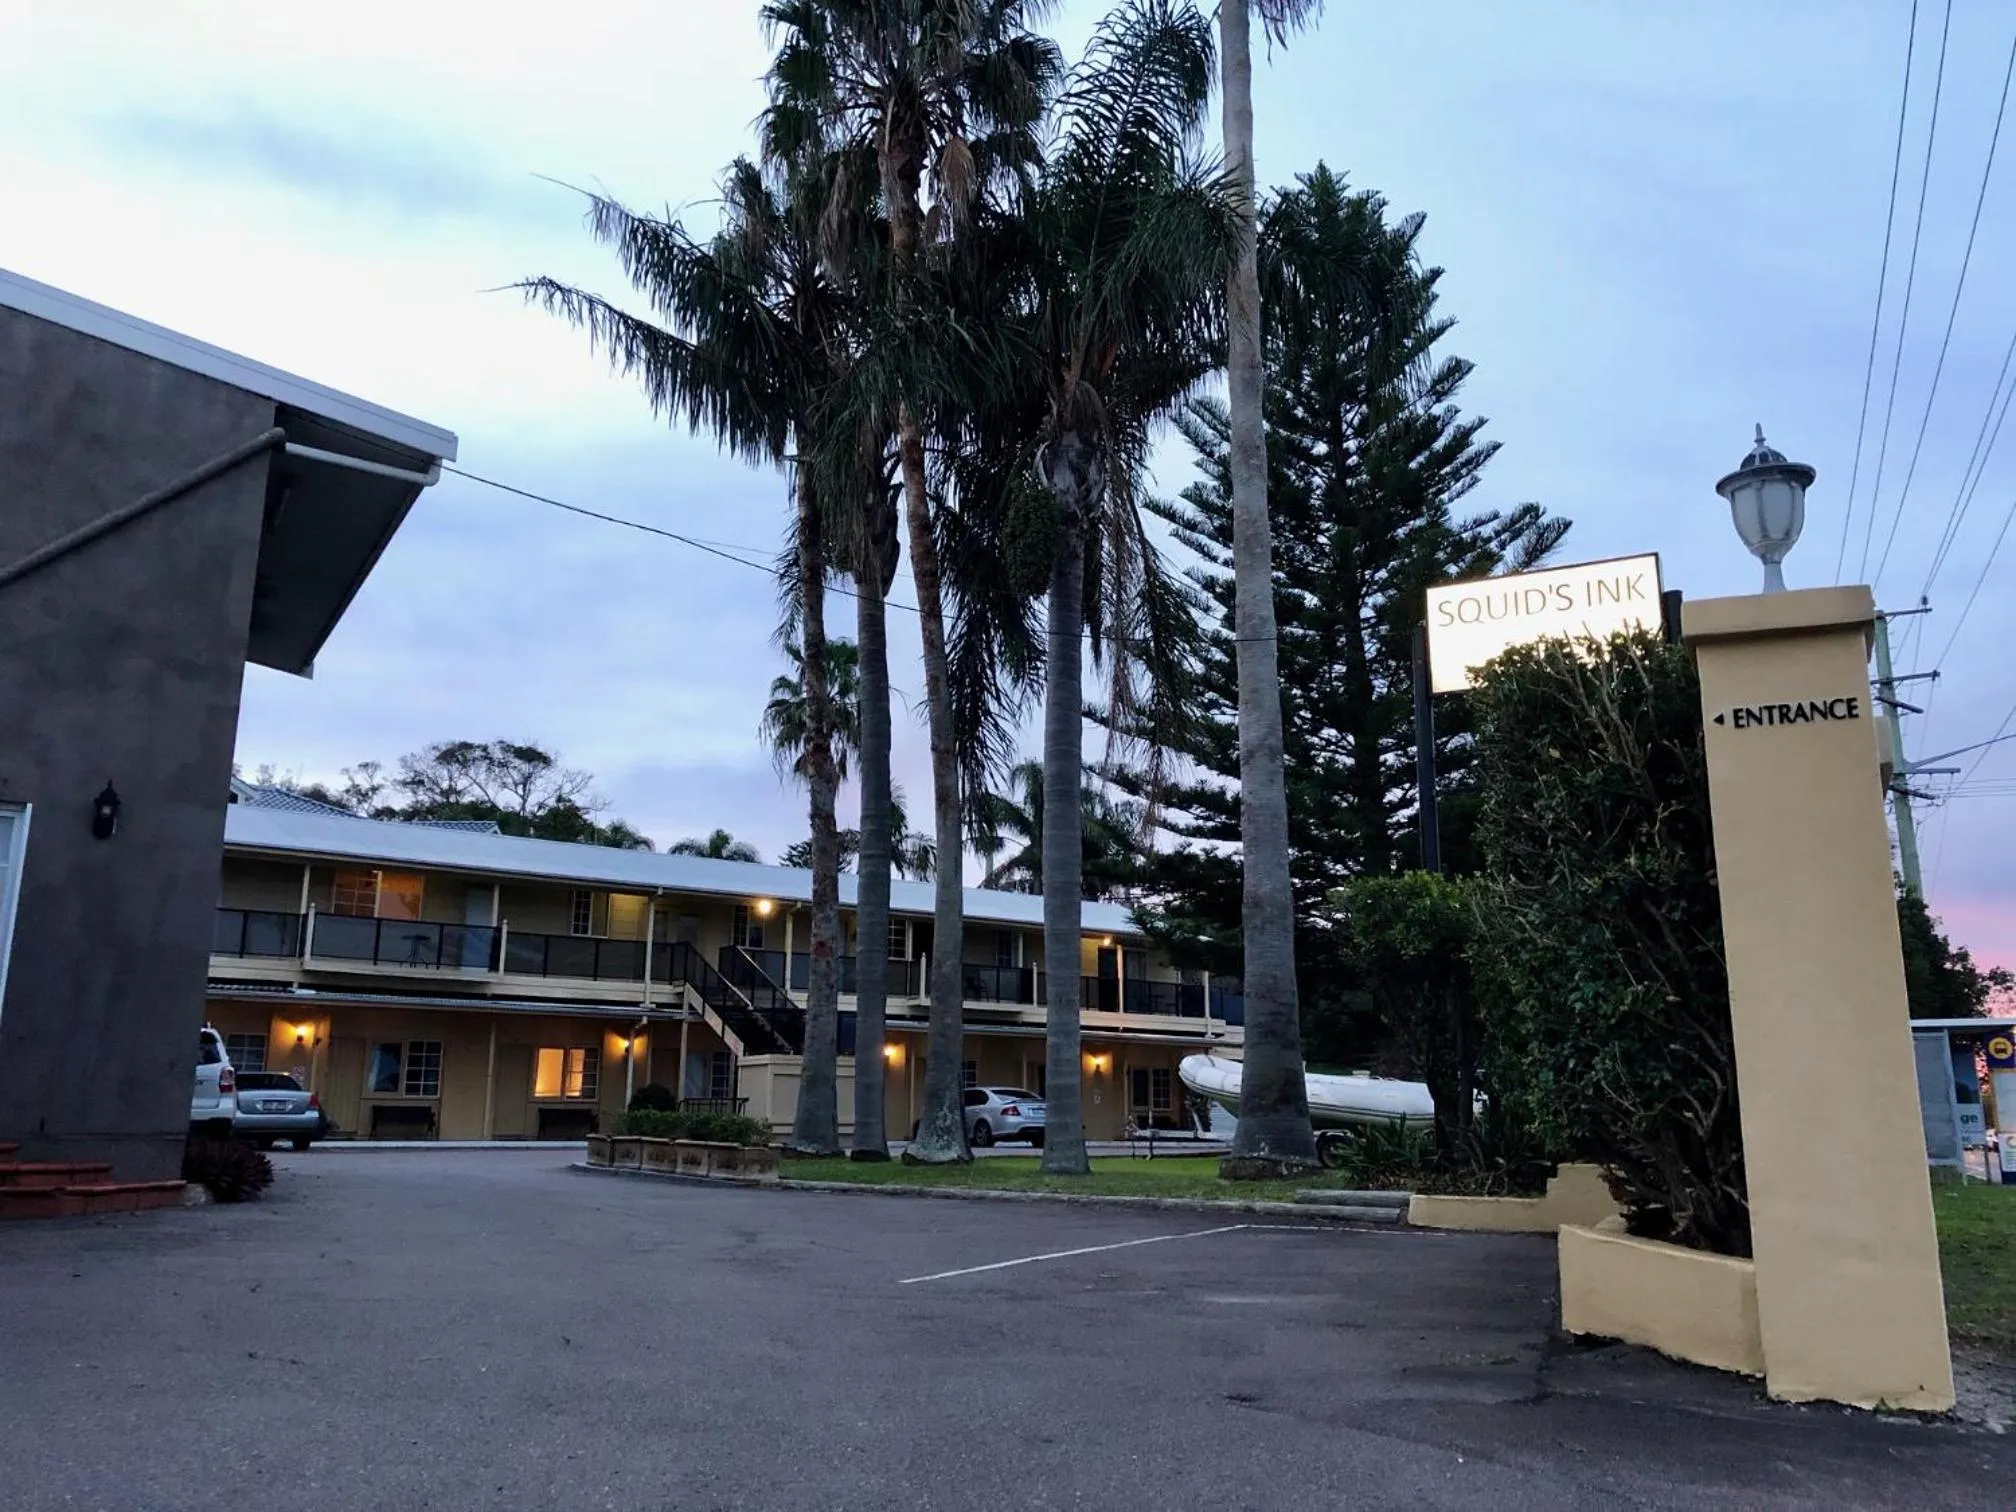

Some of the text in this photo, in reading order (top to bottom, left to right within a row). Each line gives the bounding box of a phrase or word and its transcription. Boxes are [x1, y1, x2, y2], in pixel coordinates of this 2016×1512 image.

[1438, 573, 1646, 628] SQUID'S INK
[1733, 697, 1860, 729] ENTRANCE
